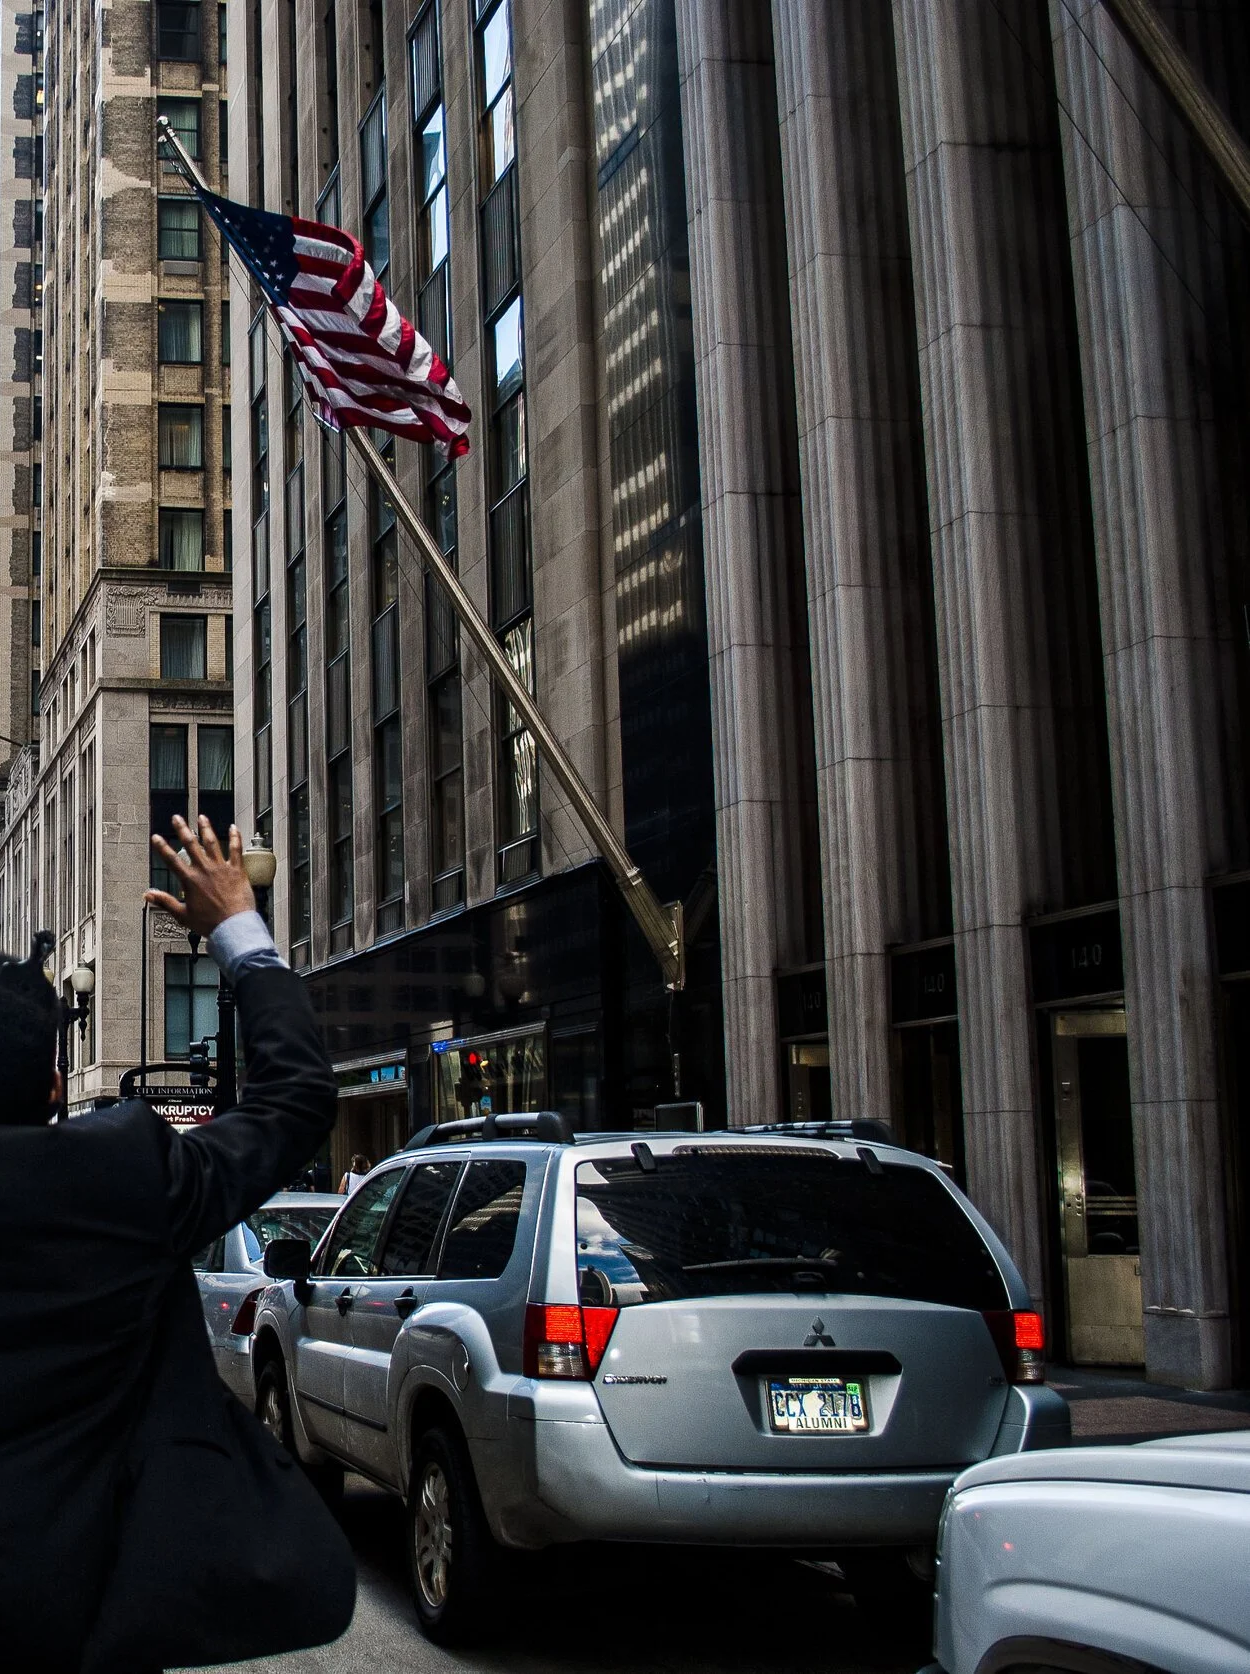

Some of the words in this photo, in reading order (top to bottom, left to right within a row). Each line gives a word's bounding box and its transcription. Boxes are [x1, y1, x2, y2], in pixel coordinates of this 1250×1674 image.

[1071, 943, 1103, 969] 140
[923, 972, 946, 994] 140
[158, 1087, 213, 1095] INFORMATION
[151, 1105, 215, 1116] NKRUPTCY
[774, 1392, 807, 1418] CCX
[796, 1417, 848, 1429] ALUMNI
